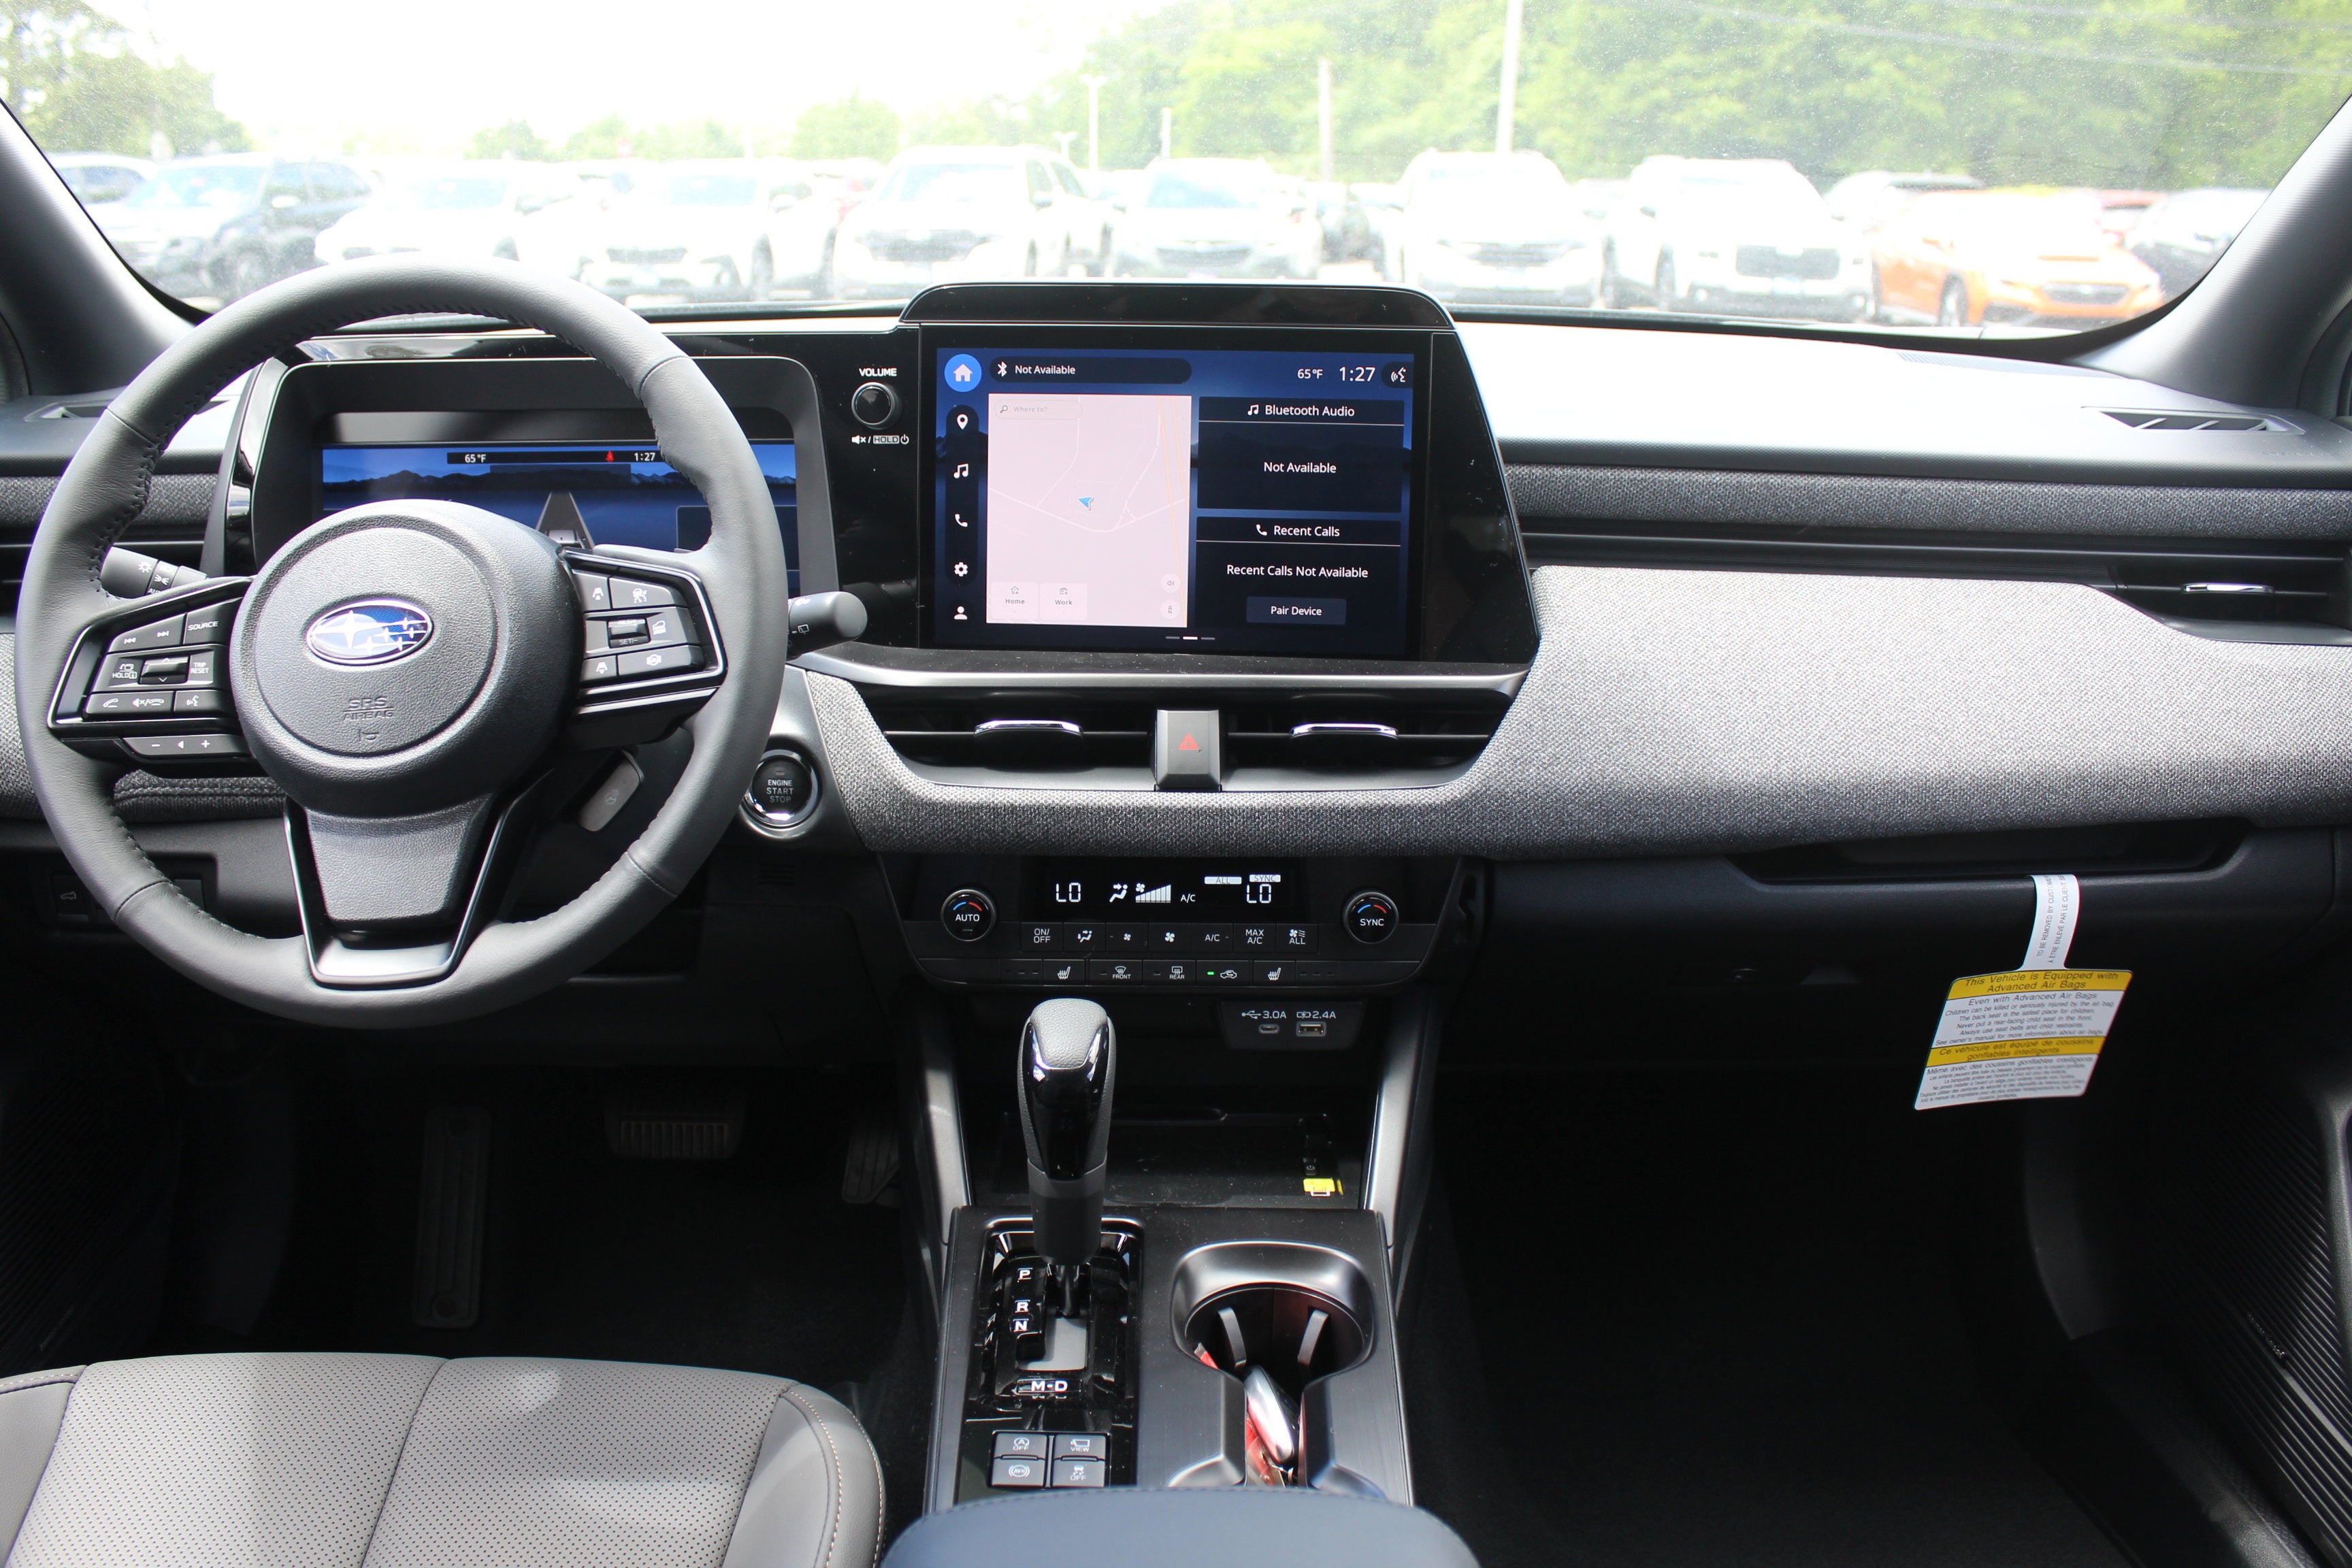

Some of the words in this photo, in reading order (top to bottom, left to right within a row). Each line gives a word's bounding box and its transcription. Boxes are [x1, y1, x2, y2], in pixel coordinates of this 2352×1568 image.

[859, 368, 897, 376] VOLUME
[1015, 365, 1032, 374] Not
[1034, 365, 1075, 374] Available
[1297, 369, 1323, 379] 65°F
[1339, 367, 1375, 382] 1:27
[1265, 405, 1319, 416] Bluetooth
[1322, 406, 1355, 416] Audio
[634, 453, 655, 461] 1:27
[1264, 462, 1284, 472] Not
[1286, 463, 1337, 473] Available
[1274, 525, 1311, 536] Recent
[1314, 526, 1340, 537] Calls
[1227, 565, 1264, 575] Recent
[1267, 566, 1292, 576] Calls
[1296, 566, 1316, 576] Not
[1319, 567, 1368, 578] Available
[1271, 606, 1288, 615] Pair
[1292, 606, 1322, 615] Device
[189, 621, 218, 631] SOURCE
[348, 696, 388, 709] SRS
[343, 710, 393, 721] AIRBAG
[1056, 883, 1081, 902] LO
[1246, 884, 1271, 903] LO
[1180, 894, 1196, 903] A/C
[2047, 905, 2053, 913] BY
[2042, 915, 2053, 941] REMOVED
[1990, 973, 2025, 983] Vehicle
[2043, 972, 2093, 981] Equipped
[1987, 982, 2037, 992] Advanced
[2059, 981, 2086, 990] Bags
[2013, 993, 2055, 1001] Advanced
[1262, 1011, 1286, 1019] 3.0A
[1955, 1044, 1989, 1054] véhicule
[1019, 1270, 1030, 1279] P
[1017, 1302, 1028, 1312] R
[1015, 1321, 1028, 1330] N
